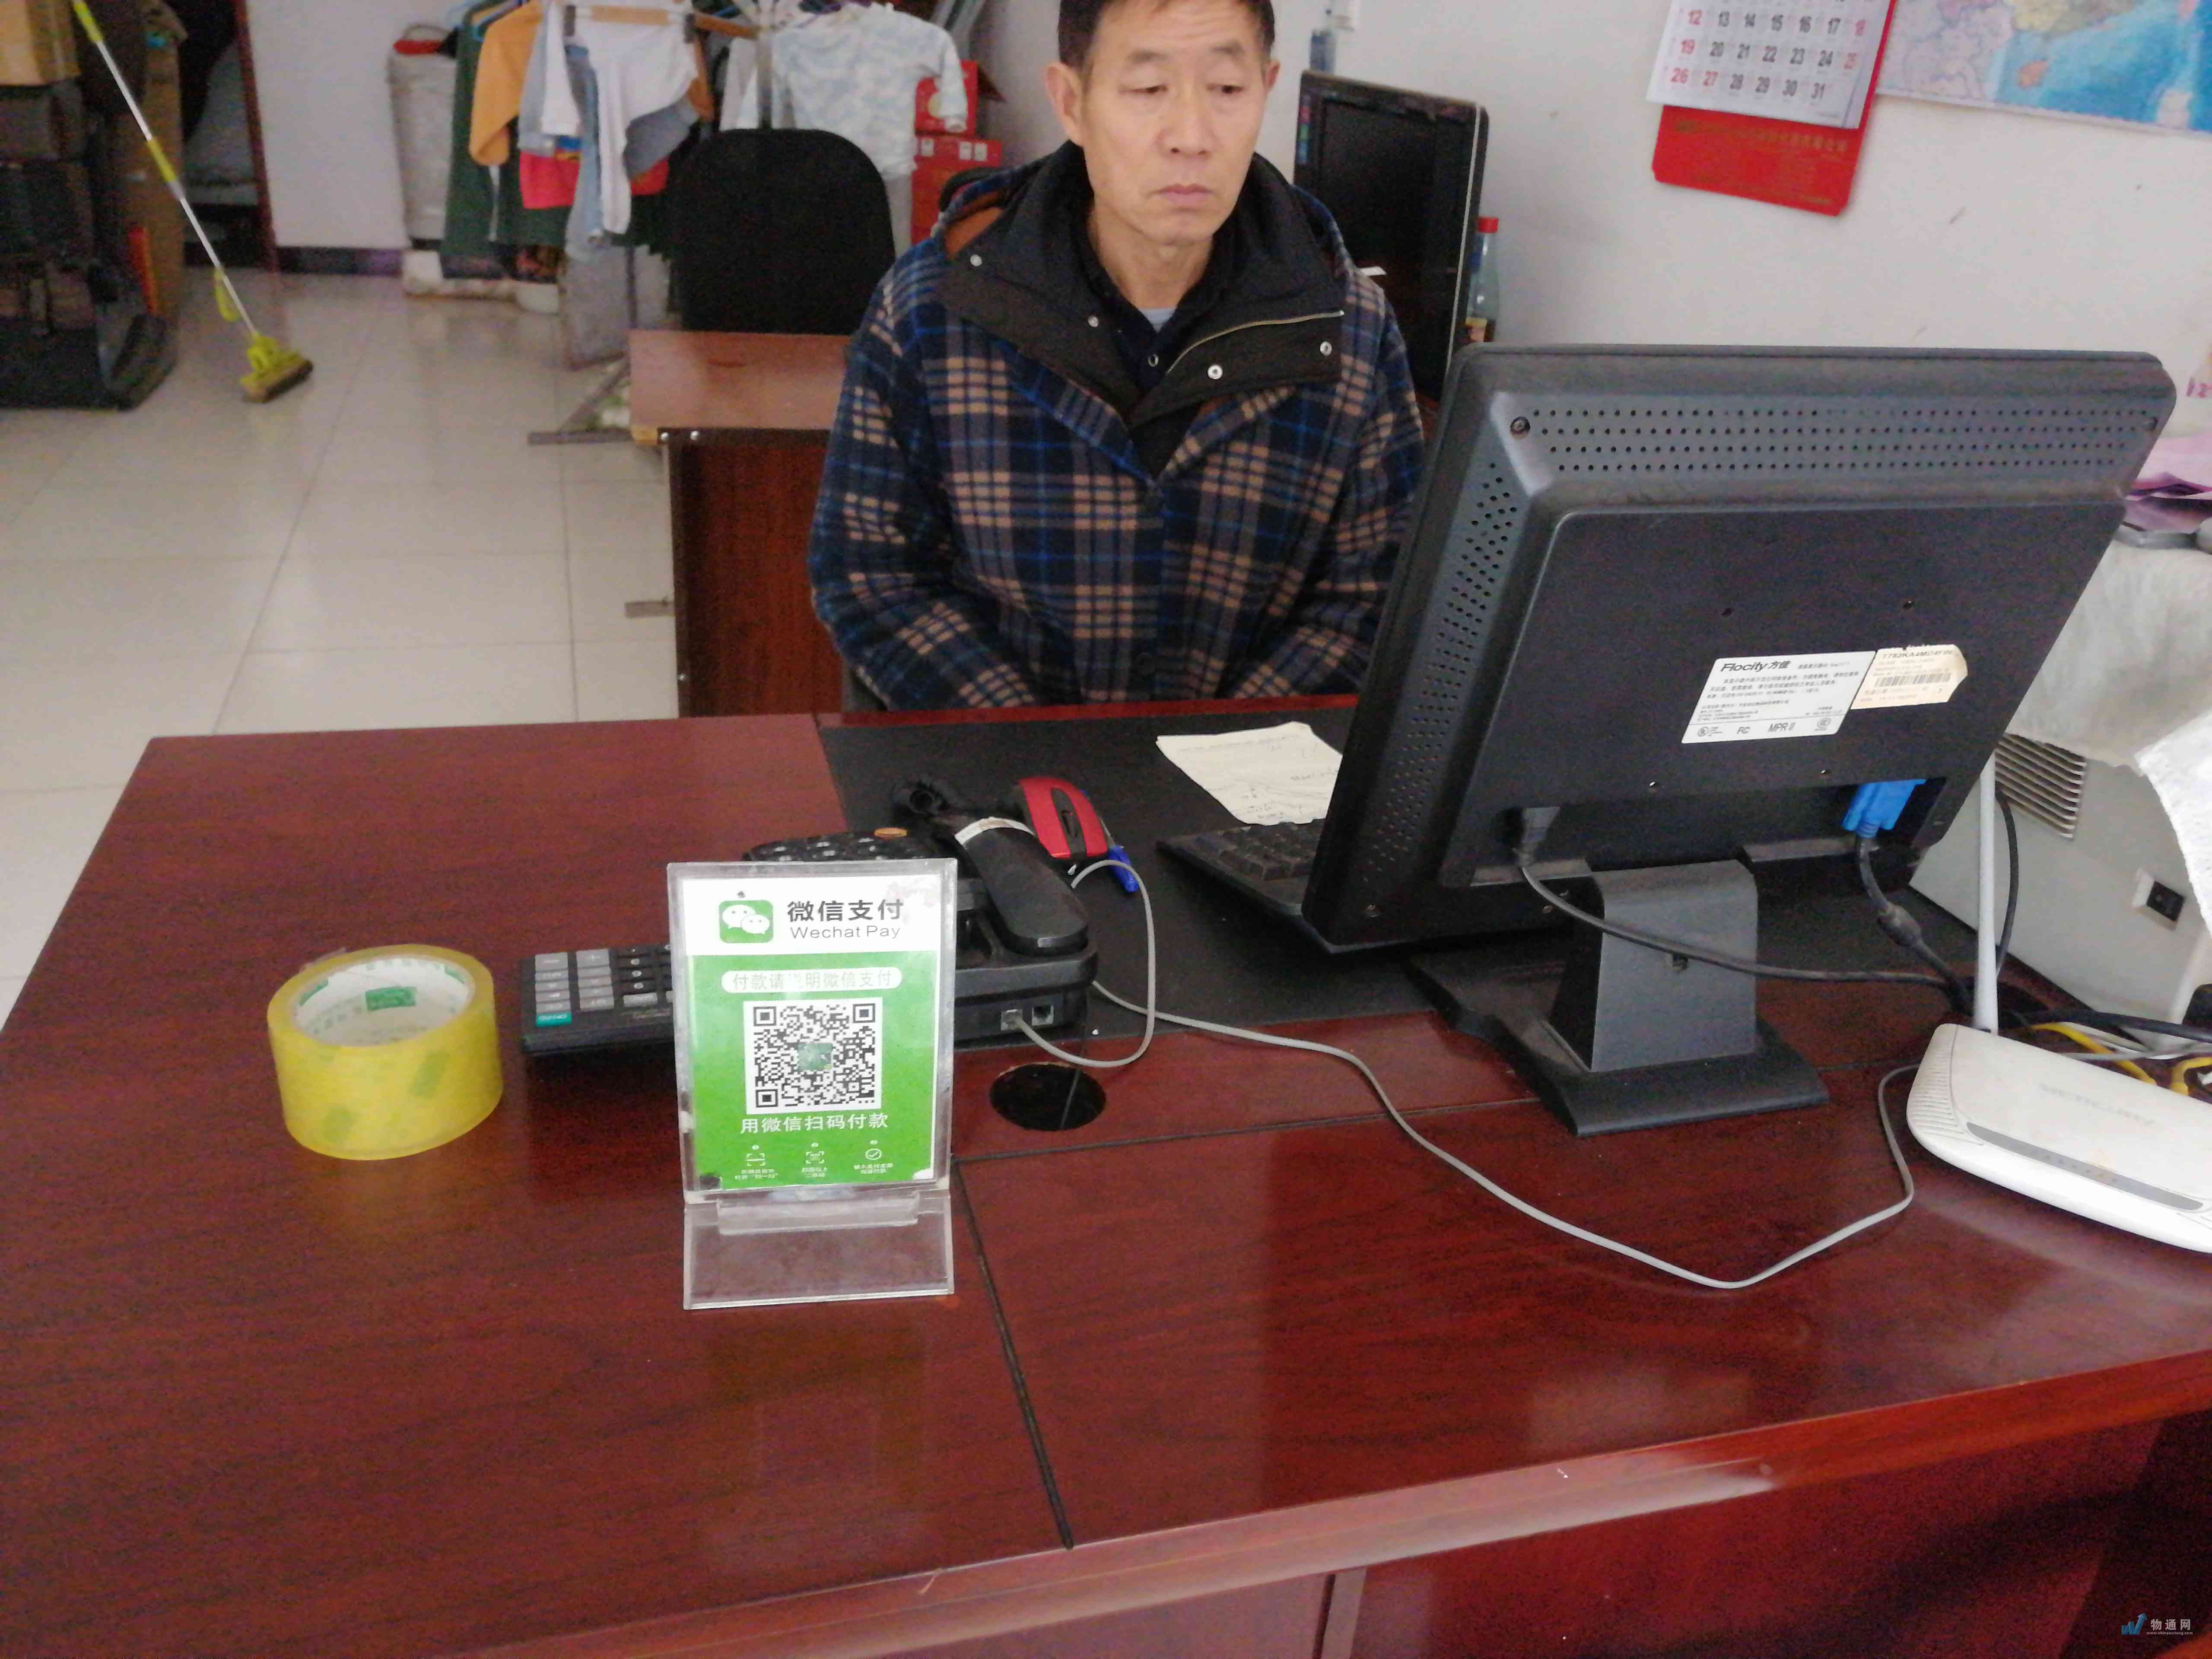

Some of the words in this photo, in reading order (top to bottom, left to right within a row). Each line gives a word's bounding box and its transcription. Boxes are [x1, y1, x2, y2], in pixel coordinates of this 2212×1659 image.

[1688, 9, 1702, 26] 12
[1718, 11, 1730, 27] 13
[1745, 13, 1756, 28] 14
[1771, 14, 1784, 32] 15
[1799, 16, 1812, 33] 16
[1827, 17, 1841, 35] 17
[1854, 19, 1866, 36] 18
[1681, 39, 1696, 55] 19
[1710, 41, 1725, 57] 20
[1737, 43, 1751, 60] 21
[1762, 45, 1778, 63] 22
[1789, 47, 1805, 65] 23
[1818, 50, 1833, 67] 24
[1843, 52, 1857, 70] 25
[1671, 67, 1689, 84] 26
[1703, 70, 1718, 86] 27
[1729, 73, 1744, 90] 28
[1755, 76, 1771, 94] 29
[1782, 79, 1798, 97] 30
[1811, 82, 1826, 100] 31
[787, 898, 904, 923] 微信支付
[790, 925, 861, 939] Wechat
[866, 925, 901, 939] Pay
[740, 1112, 889, 1135] 用微信扫码付款
